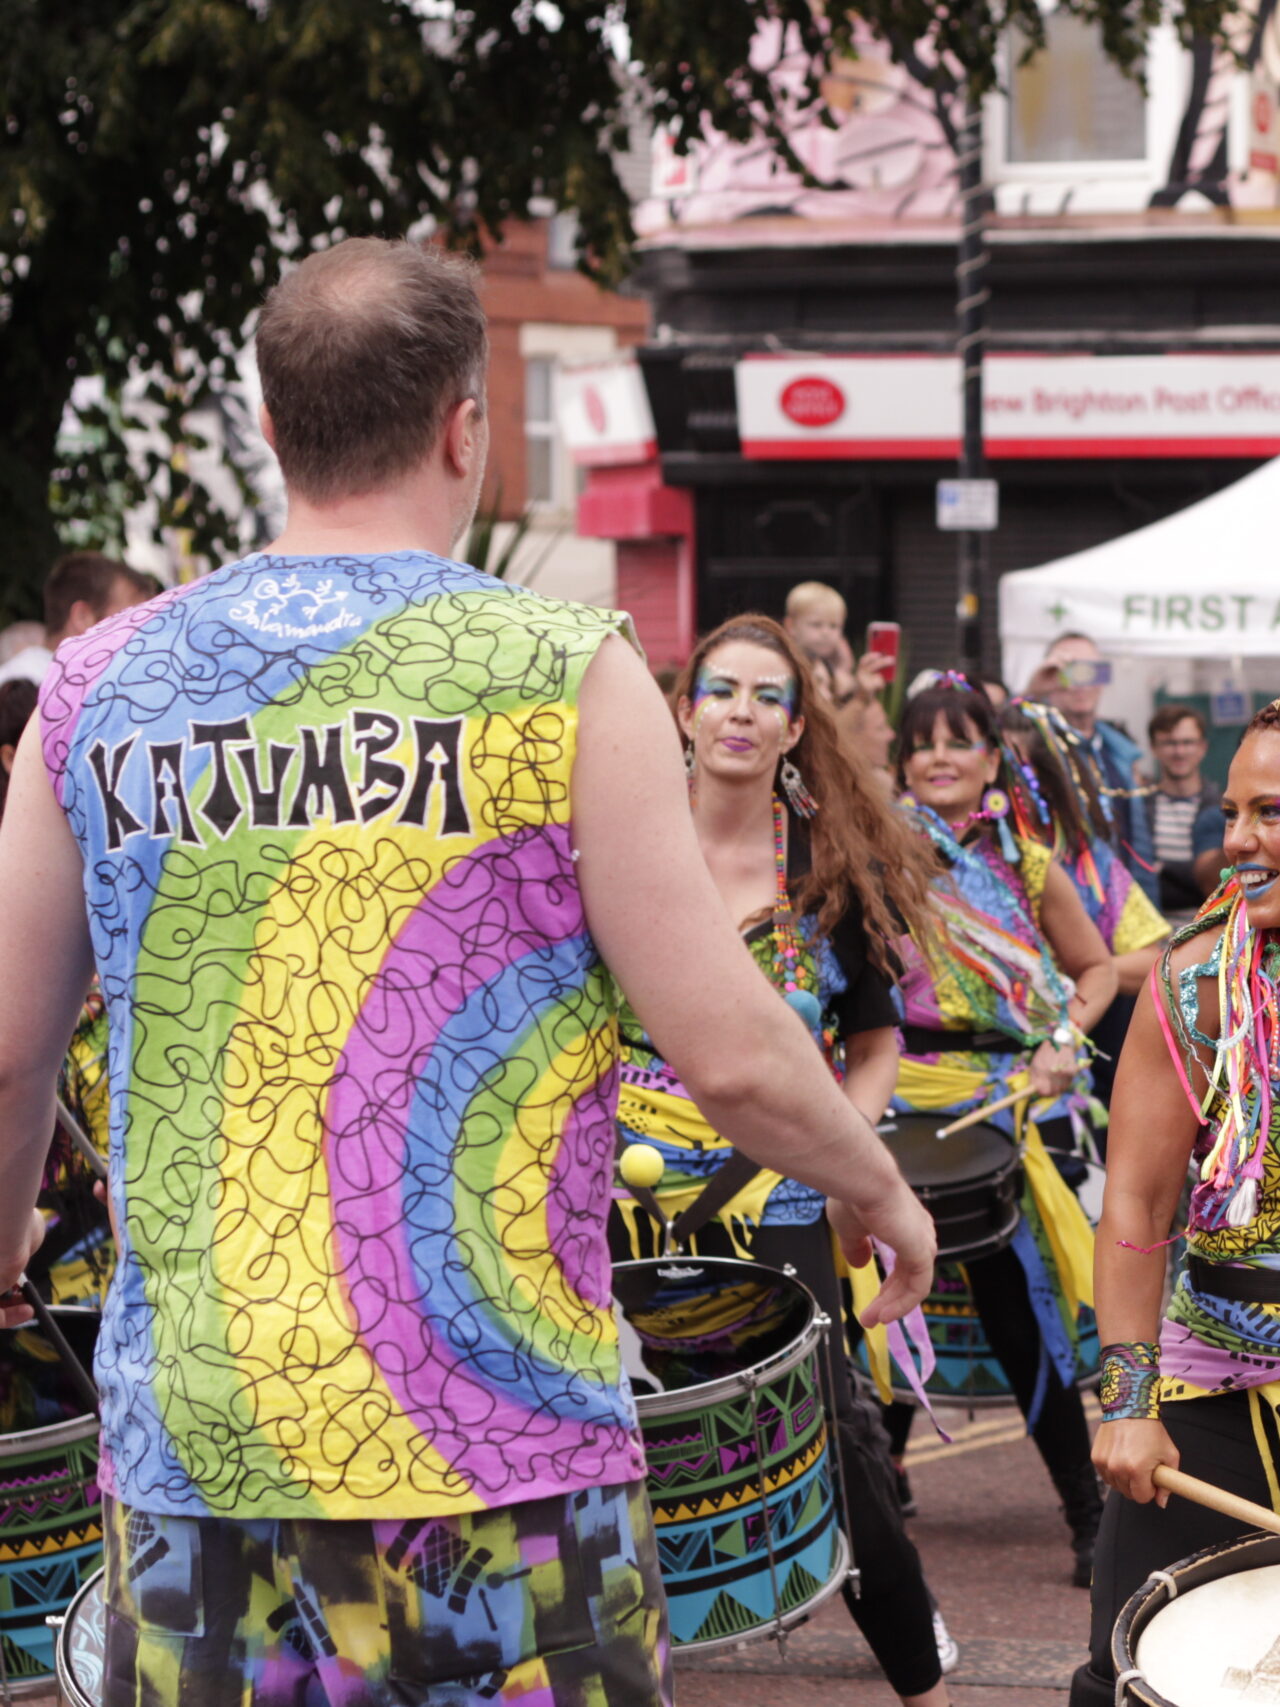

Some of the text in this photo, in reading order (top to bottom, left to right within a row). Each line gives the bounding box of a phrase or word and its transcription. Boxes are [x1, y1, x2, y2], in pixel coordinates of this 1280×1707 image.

[983, 395, 1023, 413] ew
[1033, 387, 1147, 418] Brighton
[1153, 385, 1208, 412] Post
[1123, 594, 1256, 633] FIRST
[84, 706, 477, 854] KATUMBA
